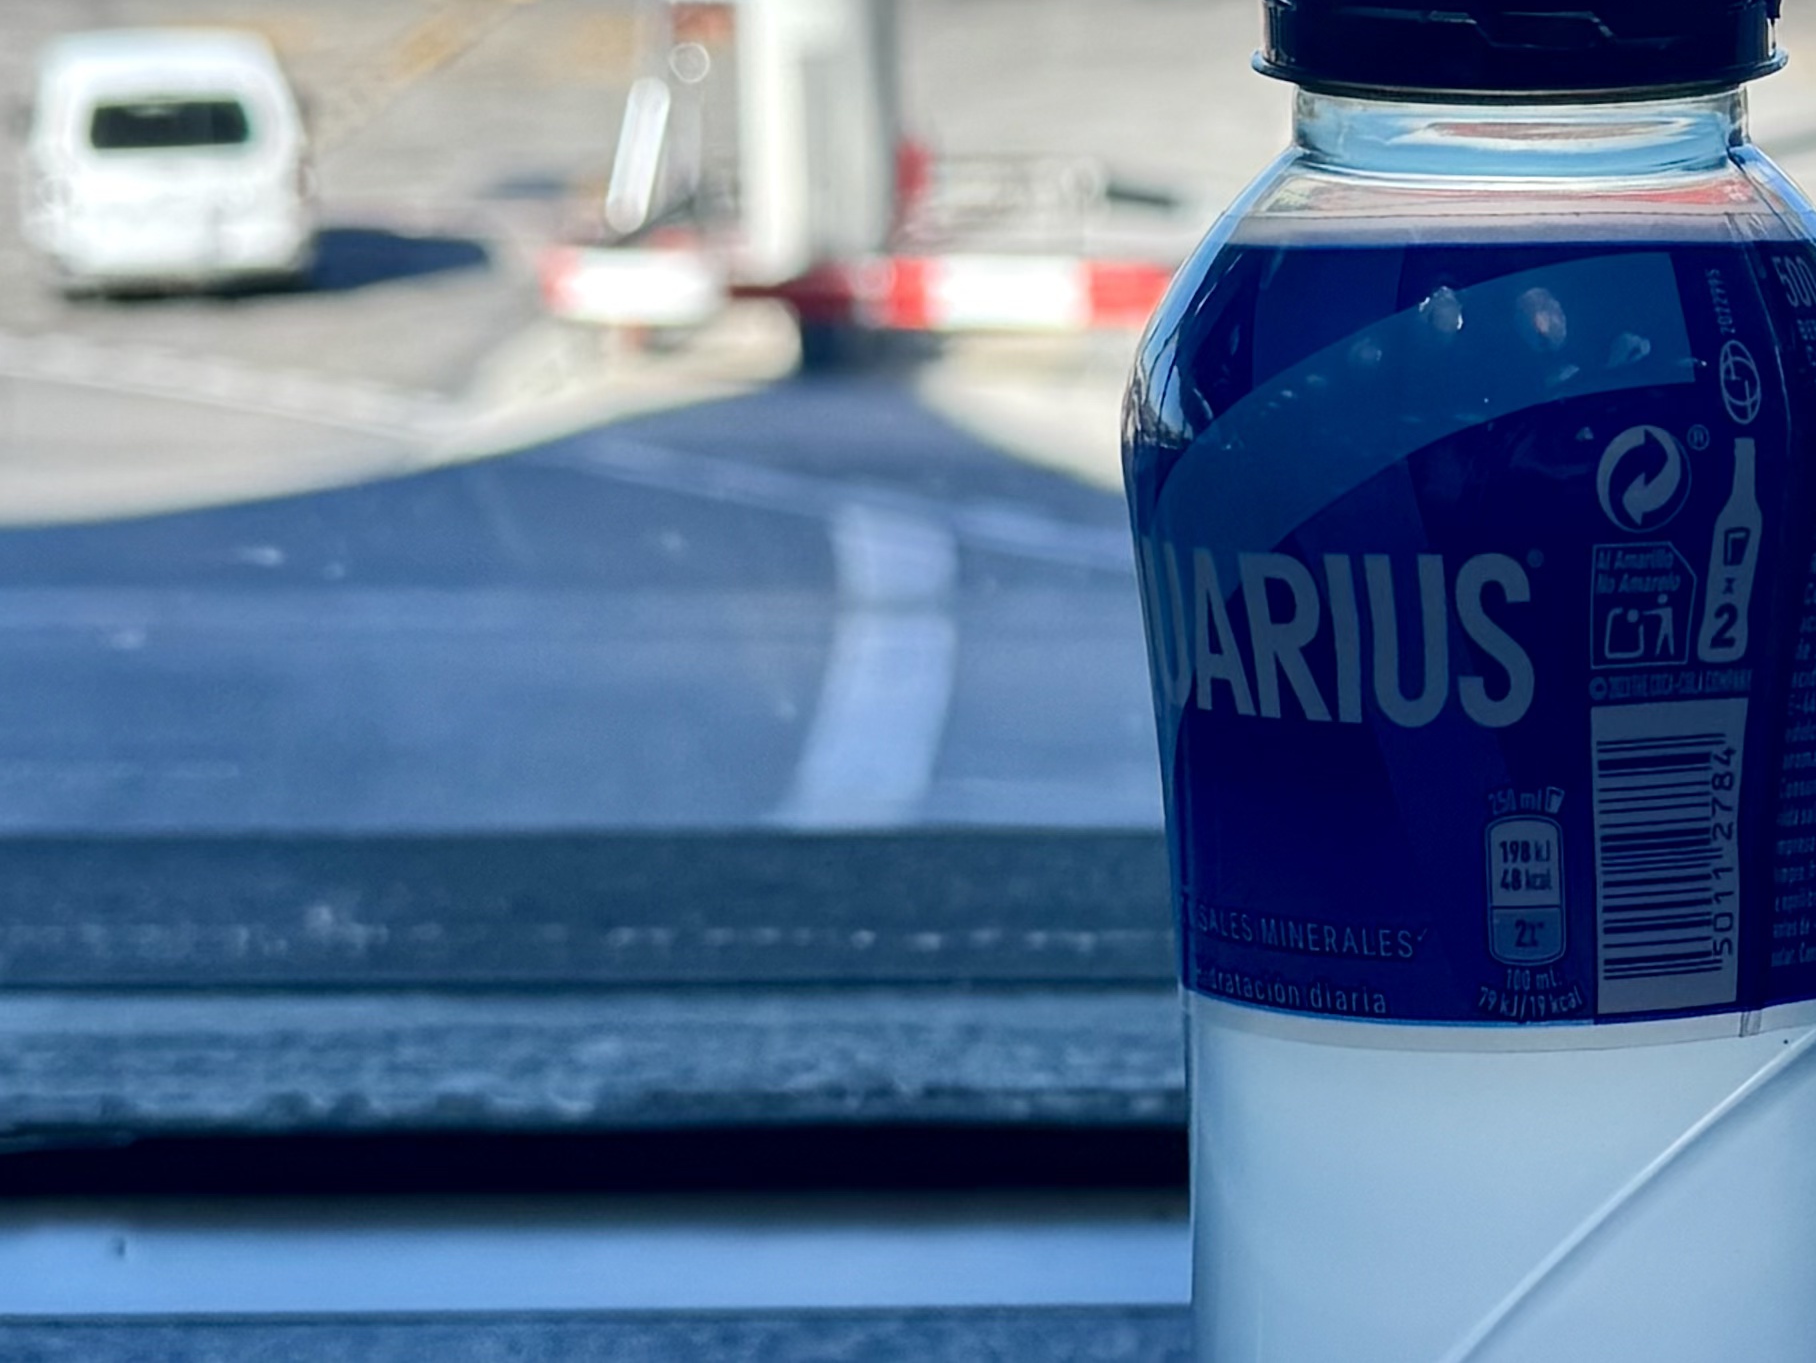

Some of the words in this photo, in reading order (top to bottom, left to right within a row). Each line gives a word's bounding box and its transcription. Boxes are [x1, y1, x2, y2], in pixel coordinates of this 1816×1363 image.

[1500, 840, 1531, 864] 198
[1500, 867, 1522, 891] 48
[1199, 903, 1253, 942] SALES
[1261, 917, 1415, 959] MINERALES
[1506, 968, 1531, 990] 100
[1310, 982, 1388, 1015] diaria
[1550, 984, 1584, 1015] kcal
